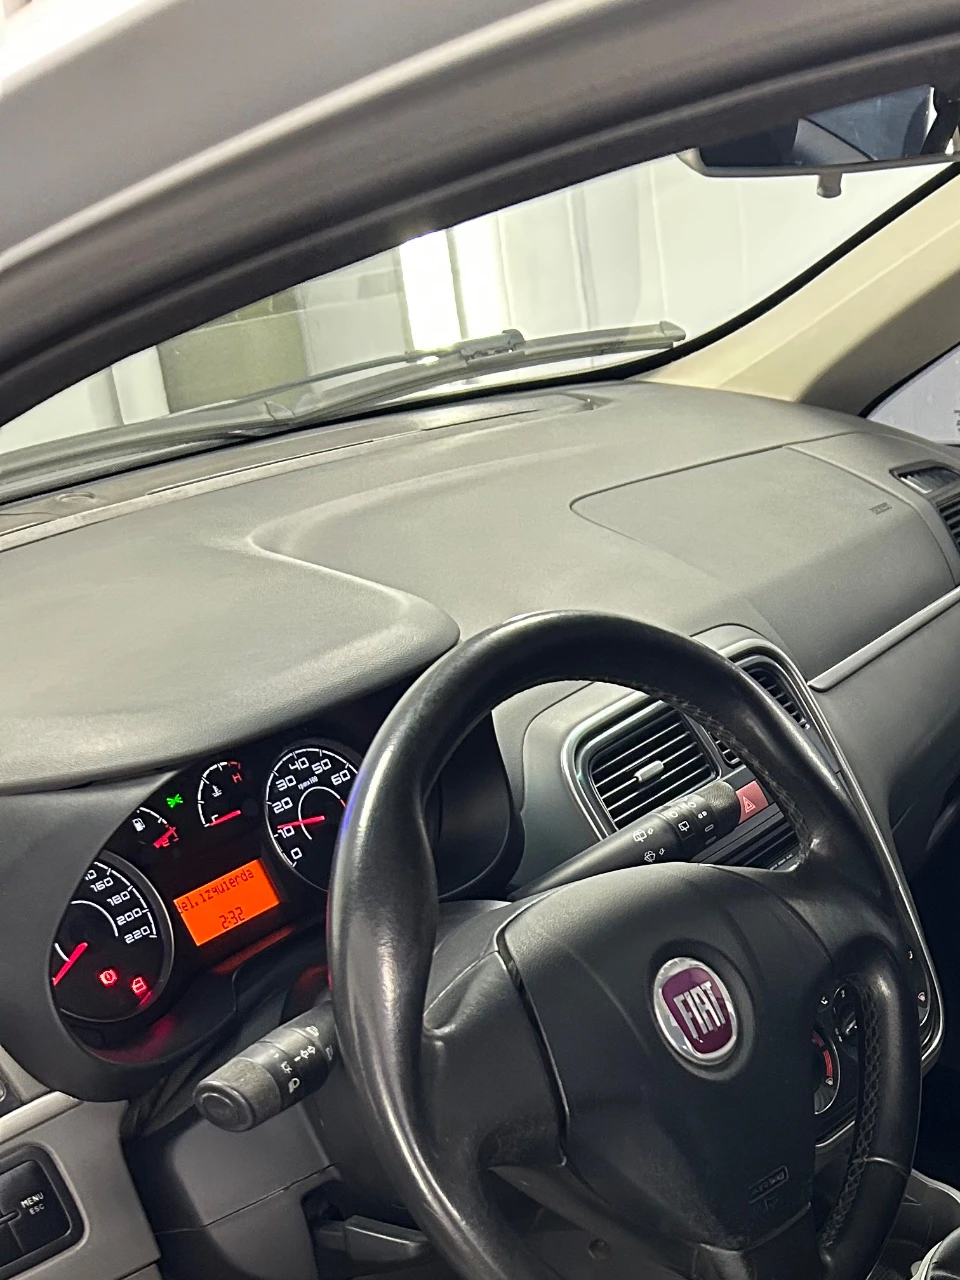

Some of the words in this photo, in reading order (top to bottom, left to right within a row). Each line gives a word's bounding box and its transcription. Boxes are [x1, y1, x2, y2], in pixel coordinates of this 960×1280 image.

[288, 757, 309, 771] 40
[311, 758, 332, 775] 50
[231, 772, 243, 783] H
[275, 775, 297, 791] 30
[330, 769, 351, 786] 60
[271, 797, 294, 814] 20
[277, 825, 295, 839] 10
[290, 847, 303, 860] 0
[89, 877, 114, 893] 160
[106, 891, 131, 907] 180
[115, 907, 143, 926] 200
[123, 925, 151, 944] 220
[672, 980, 727, 1040] FIAT
[20, 1192, 44, 1209] MENU
[29, 1203, 45, 1215] ESC
